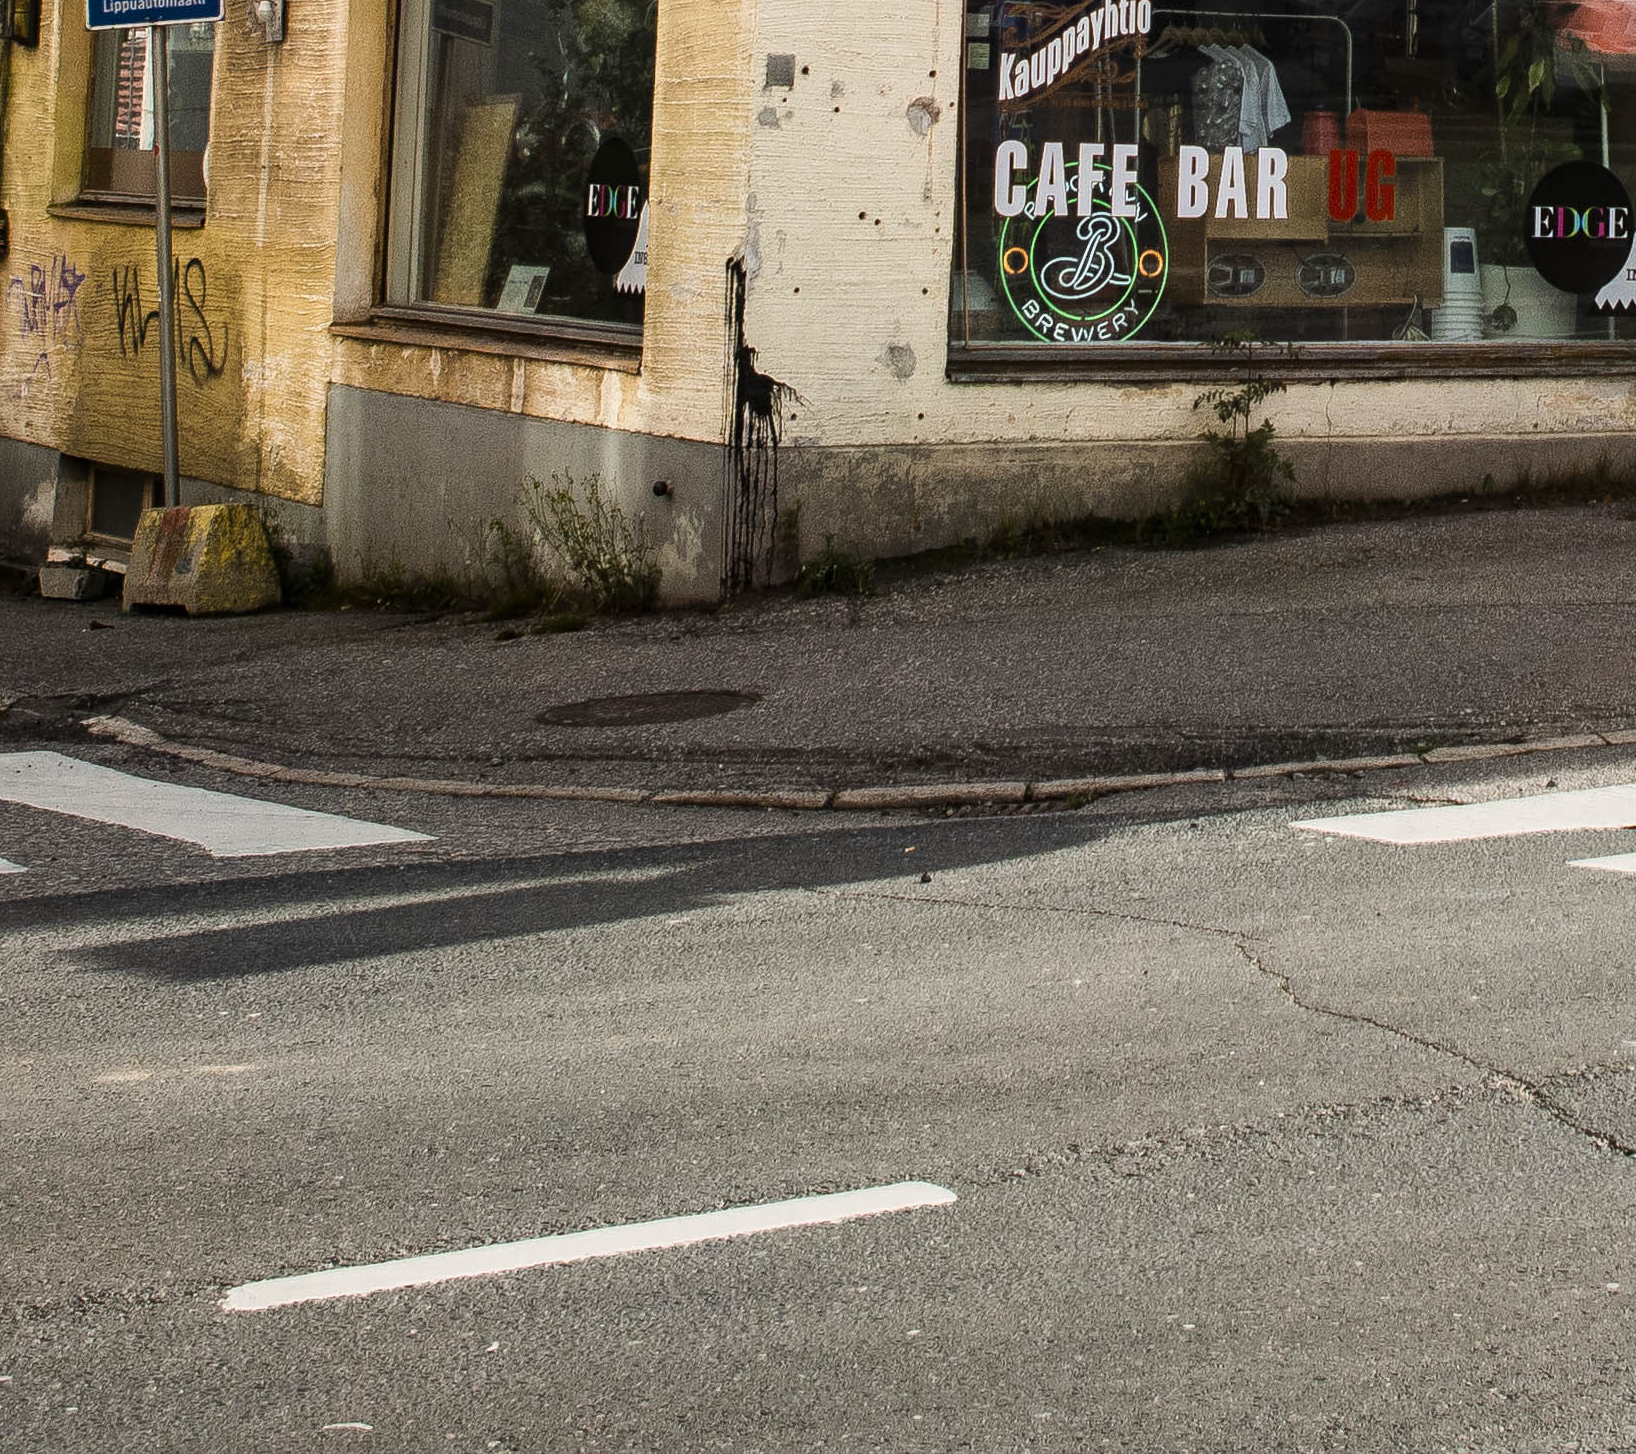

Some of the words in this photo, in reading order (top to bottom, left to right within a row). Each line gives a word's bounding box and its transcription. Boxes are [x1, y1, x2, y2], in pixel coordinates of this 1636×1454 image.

[587, 183, 639, 219] EDGE
[994, 140, 1139, 218] CAFE
[1177, 145, 1289, 221] BAR
[1328, 148, 1396, 222] UG
[1531, 205, 1629, 239] EDGE
[1020, 298, 1140, 342] BREWERY
